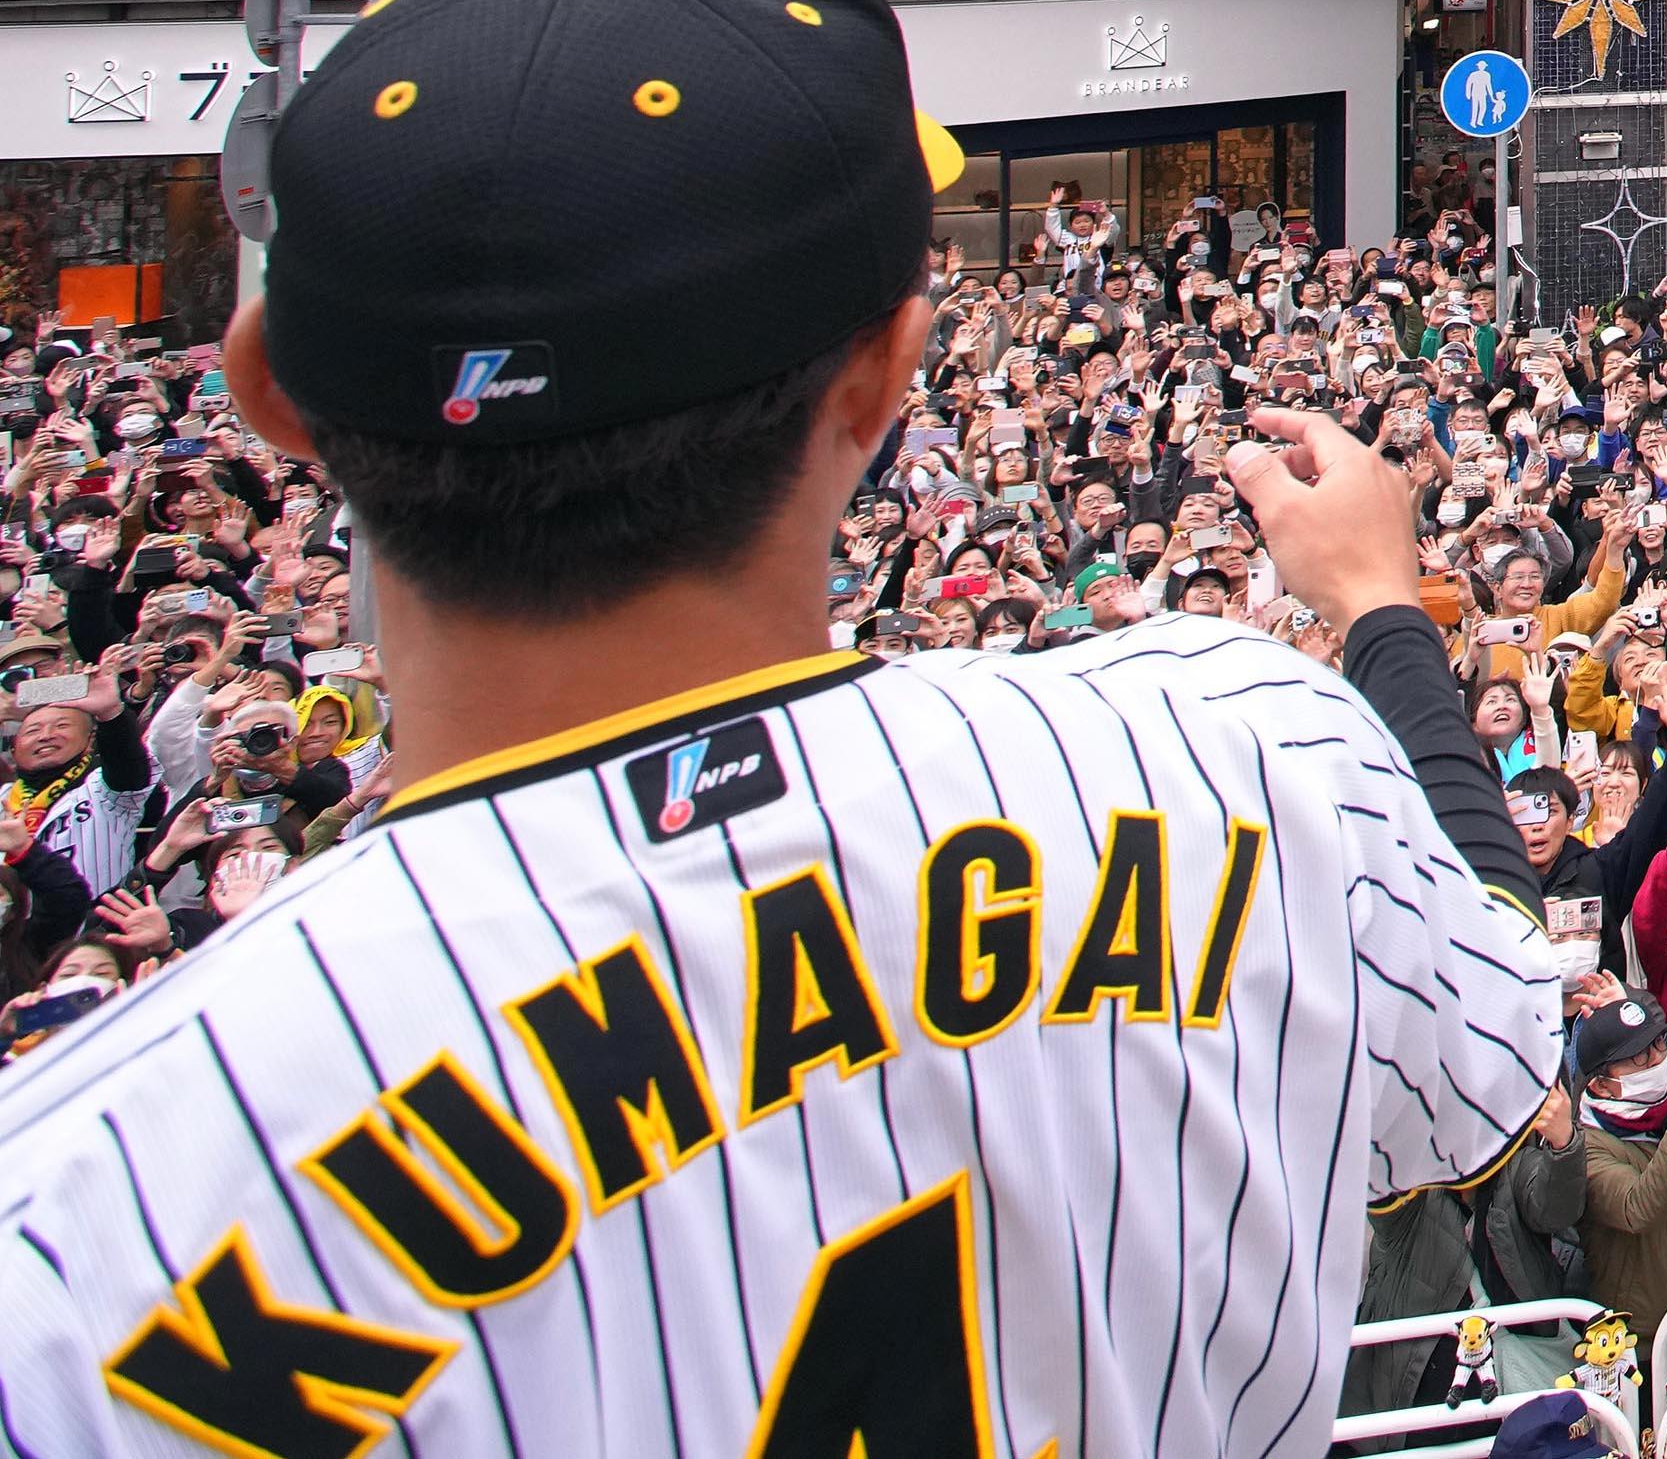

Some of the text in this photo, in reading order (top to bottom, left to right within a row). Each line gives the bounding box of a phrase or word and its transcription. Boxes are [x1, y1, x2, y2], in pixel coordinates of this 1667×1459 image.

[1082, 75, 1191, 97] BRANDEAR
[480, 375, 549, 399] NPB
[694, 752, 762, 793] NPB
[102, 806, 1268, 1459] KUMAGAI
